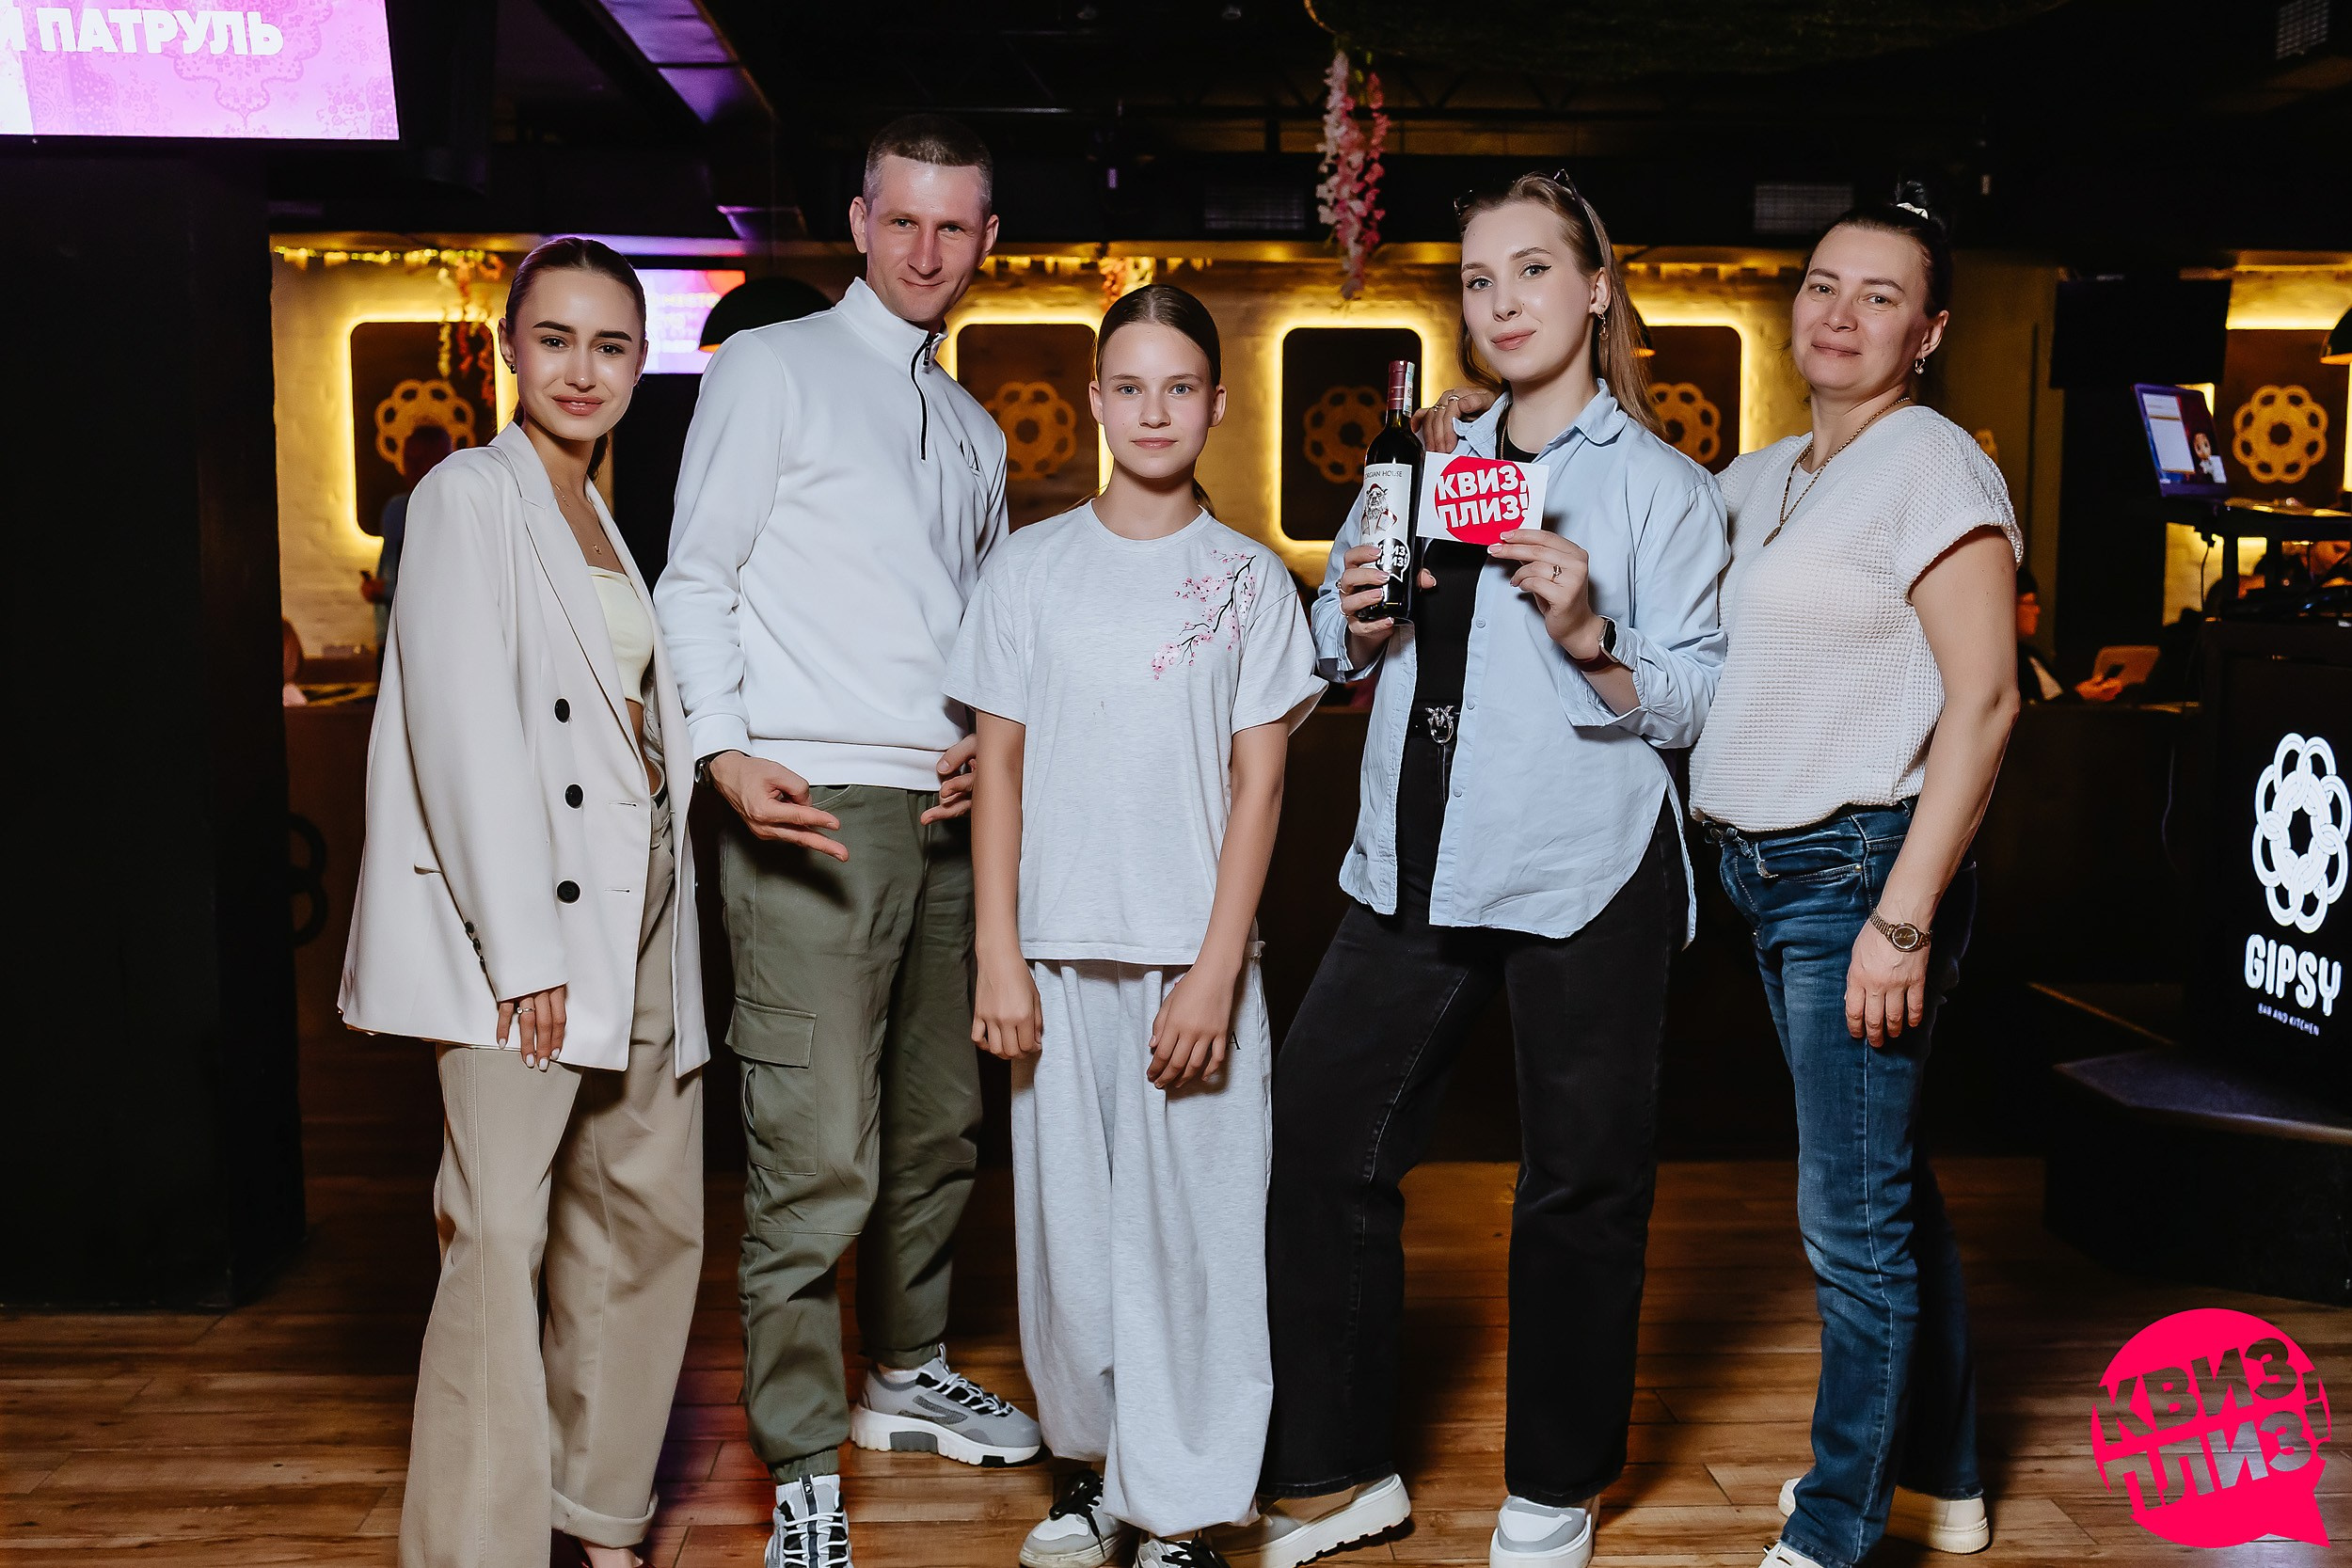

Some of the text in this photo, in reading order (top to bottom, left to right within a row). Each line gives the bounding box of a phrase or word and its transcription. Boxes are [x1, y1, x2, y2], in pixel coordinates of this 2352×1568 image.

[36, 8, 284, 55] ПАТРУЛЬ
[1437, 494, 1529, 528] ПЛИЗ!
[2245, 934, 2342, 1017] GIPSY
[2273, 1009, 2288, 1023] AND
[2289, 1016, 2320, 1036] KITCHEN
